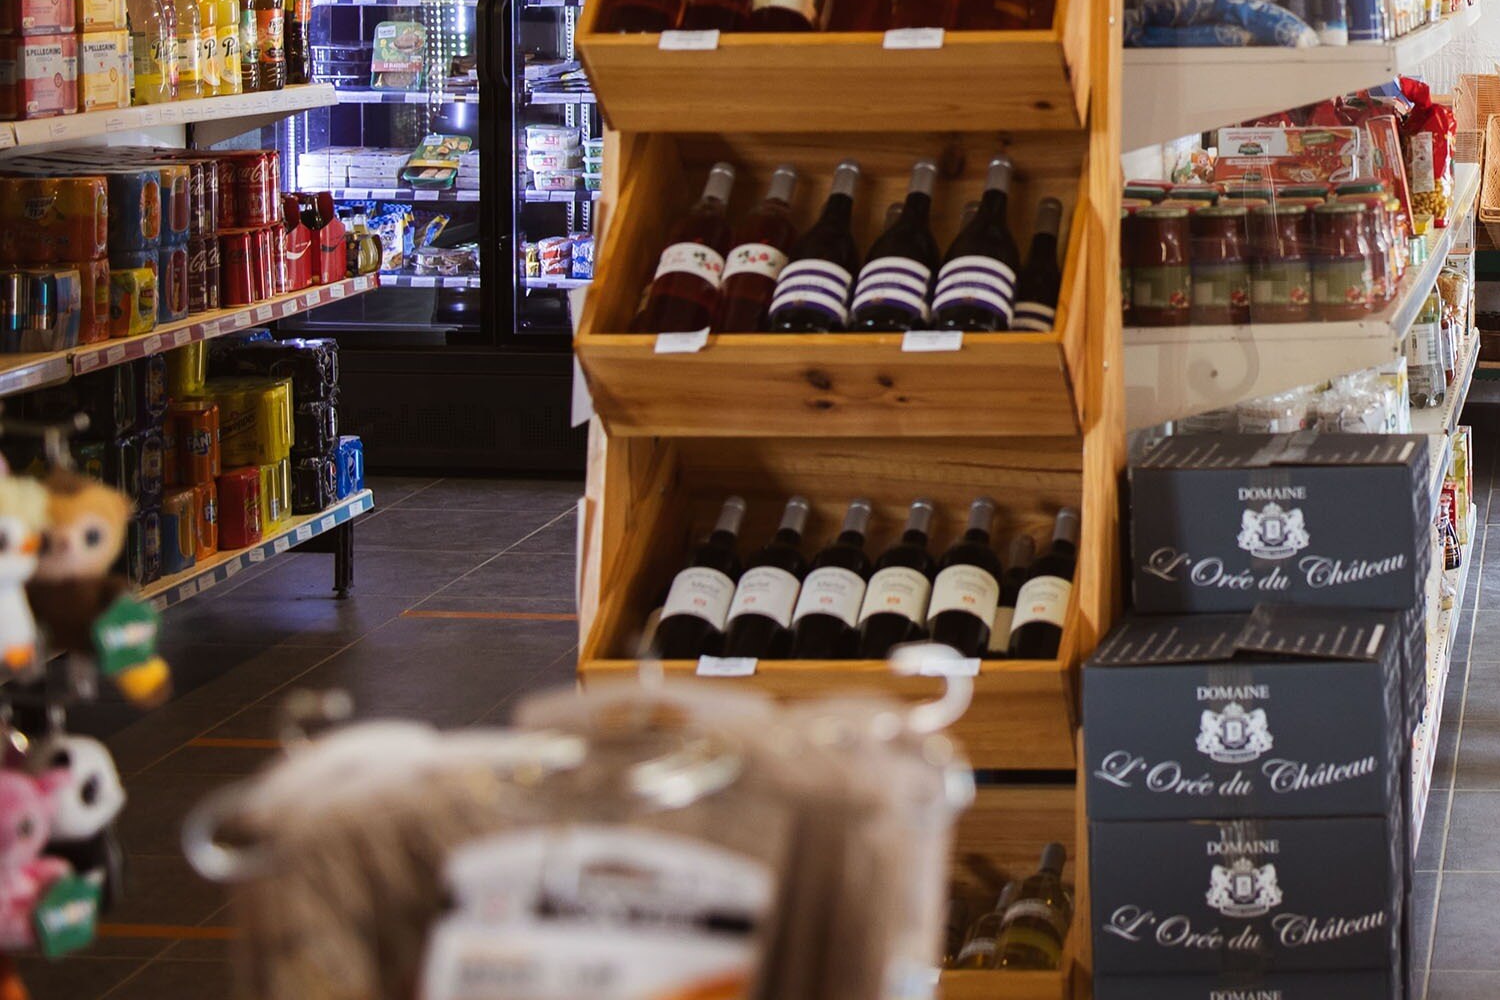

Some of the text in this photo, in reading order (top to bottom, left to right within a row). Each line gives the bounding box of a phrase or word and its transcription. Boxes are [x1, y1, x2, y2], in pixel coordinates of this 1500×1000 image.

[1238, 487, 1307, 500] DOMAINE
[1258, 566, 1290, 590] du
[1300, 553, 1407, 588] Château
[1197, 685, 1270, 700] DOMAINE
[1218, 771, 1253, 796] du
[1261, 756, 1378, 794] Château
[1207, 839, 1280, 855] DOMAINE
[1228, 925, 1261, 950] du
[1271, 910, 1386, 948] Château
[1210, 990, 1282, 1000] DOMAINE
